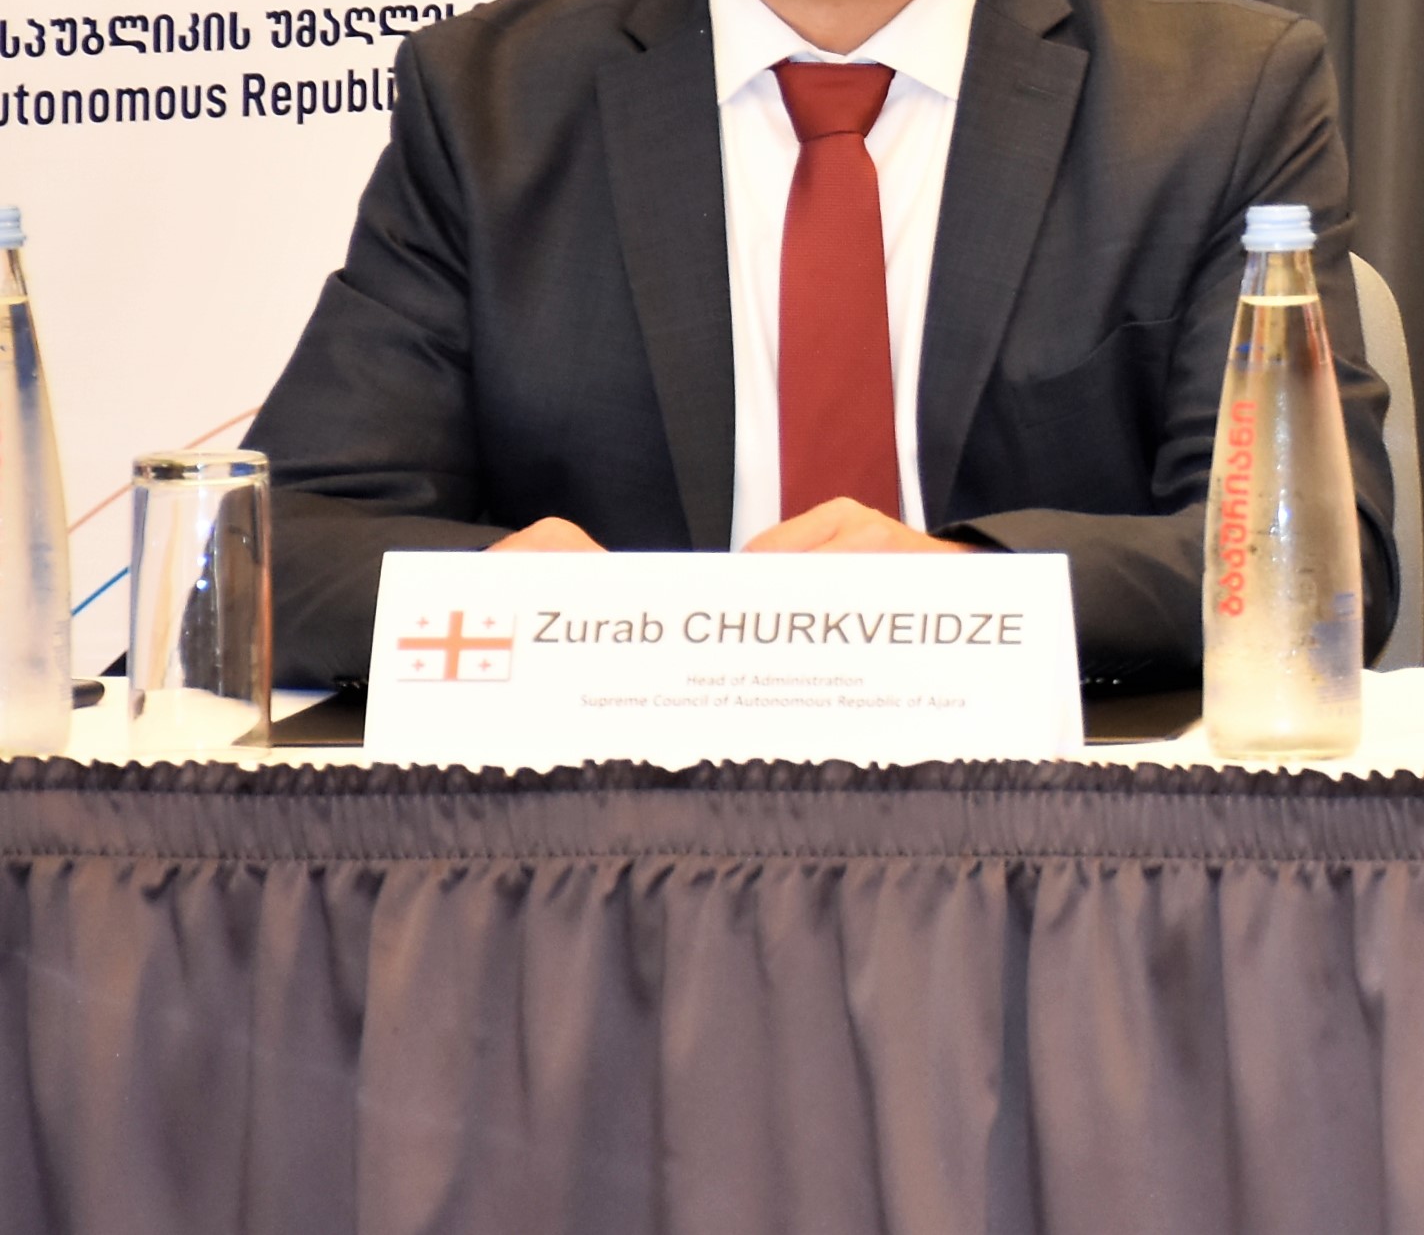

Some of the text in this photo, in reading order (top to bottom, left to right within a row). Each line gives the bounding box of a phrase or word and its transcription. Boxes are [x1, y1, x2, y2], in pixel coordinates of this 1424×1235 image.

[265, 3, 454, 49] უმაღლ
[532, 610, 1024, 645] Zurab CHURKVEIDZE
[686, 674, 864, 688] Head of Administration
[580, 694, 967, 711] Supreme Council of Autonomous Republic of Ajara
